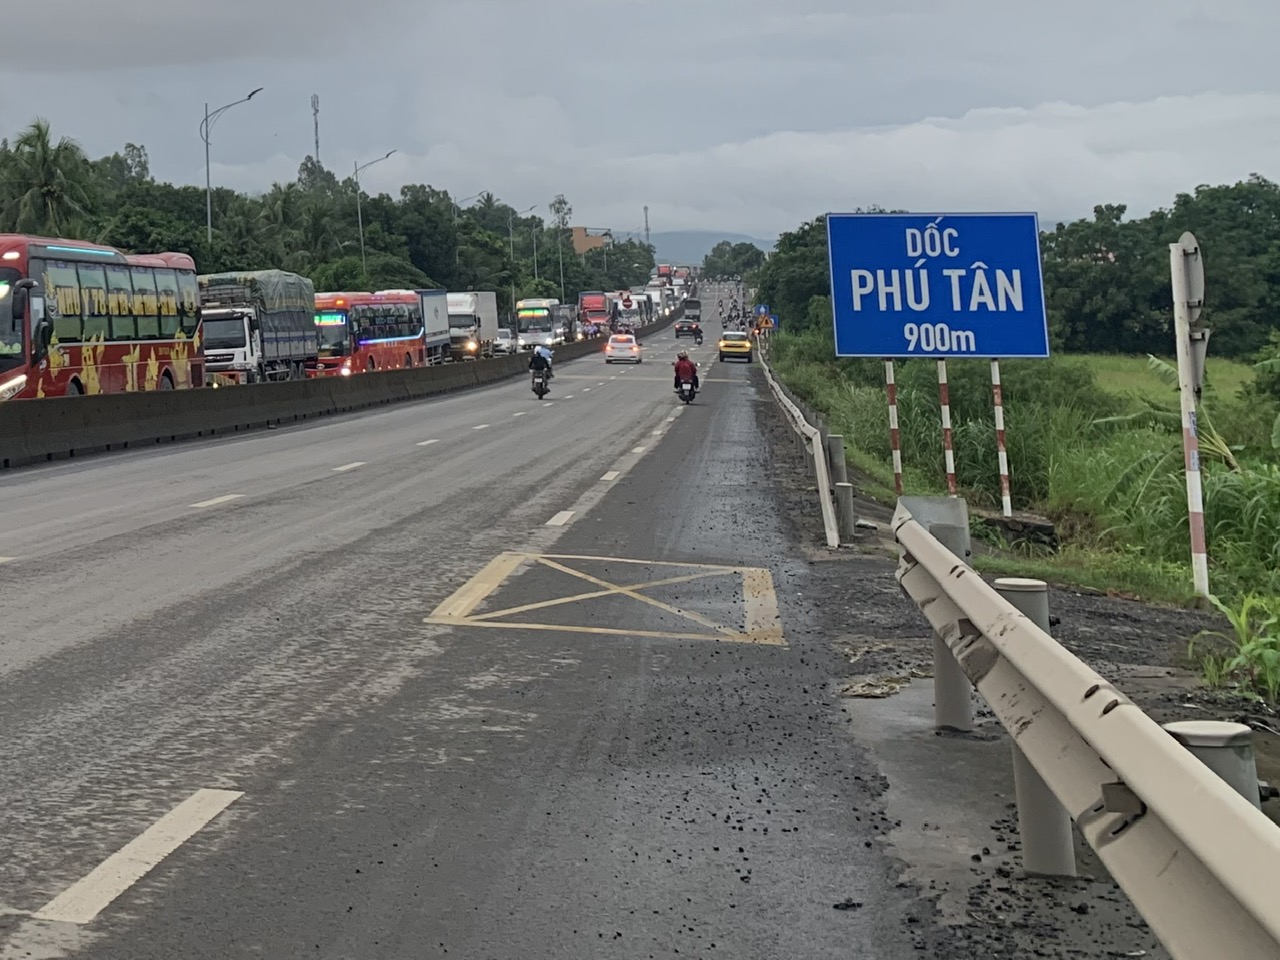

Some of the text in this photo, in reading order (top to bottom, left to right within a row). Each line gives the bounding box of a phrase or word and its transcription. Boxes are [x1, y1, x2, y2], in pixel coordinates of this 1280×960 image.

[905, 216, 960, 257] DỐC
[850, 258, 1024, 312] PHÚ TÂN
[903, 323, 976, 352] 900m
